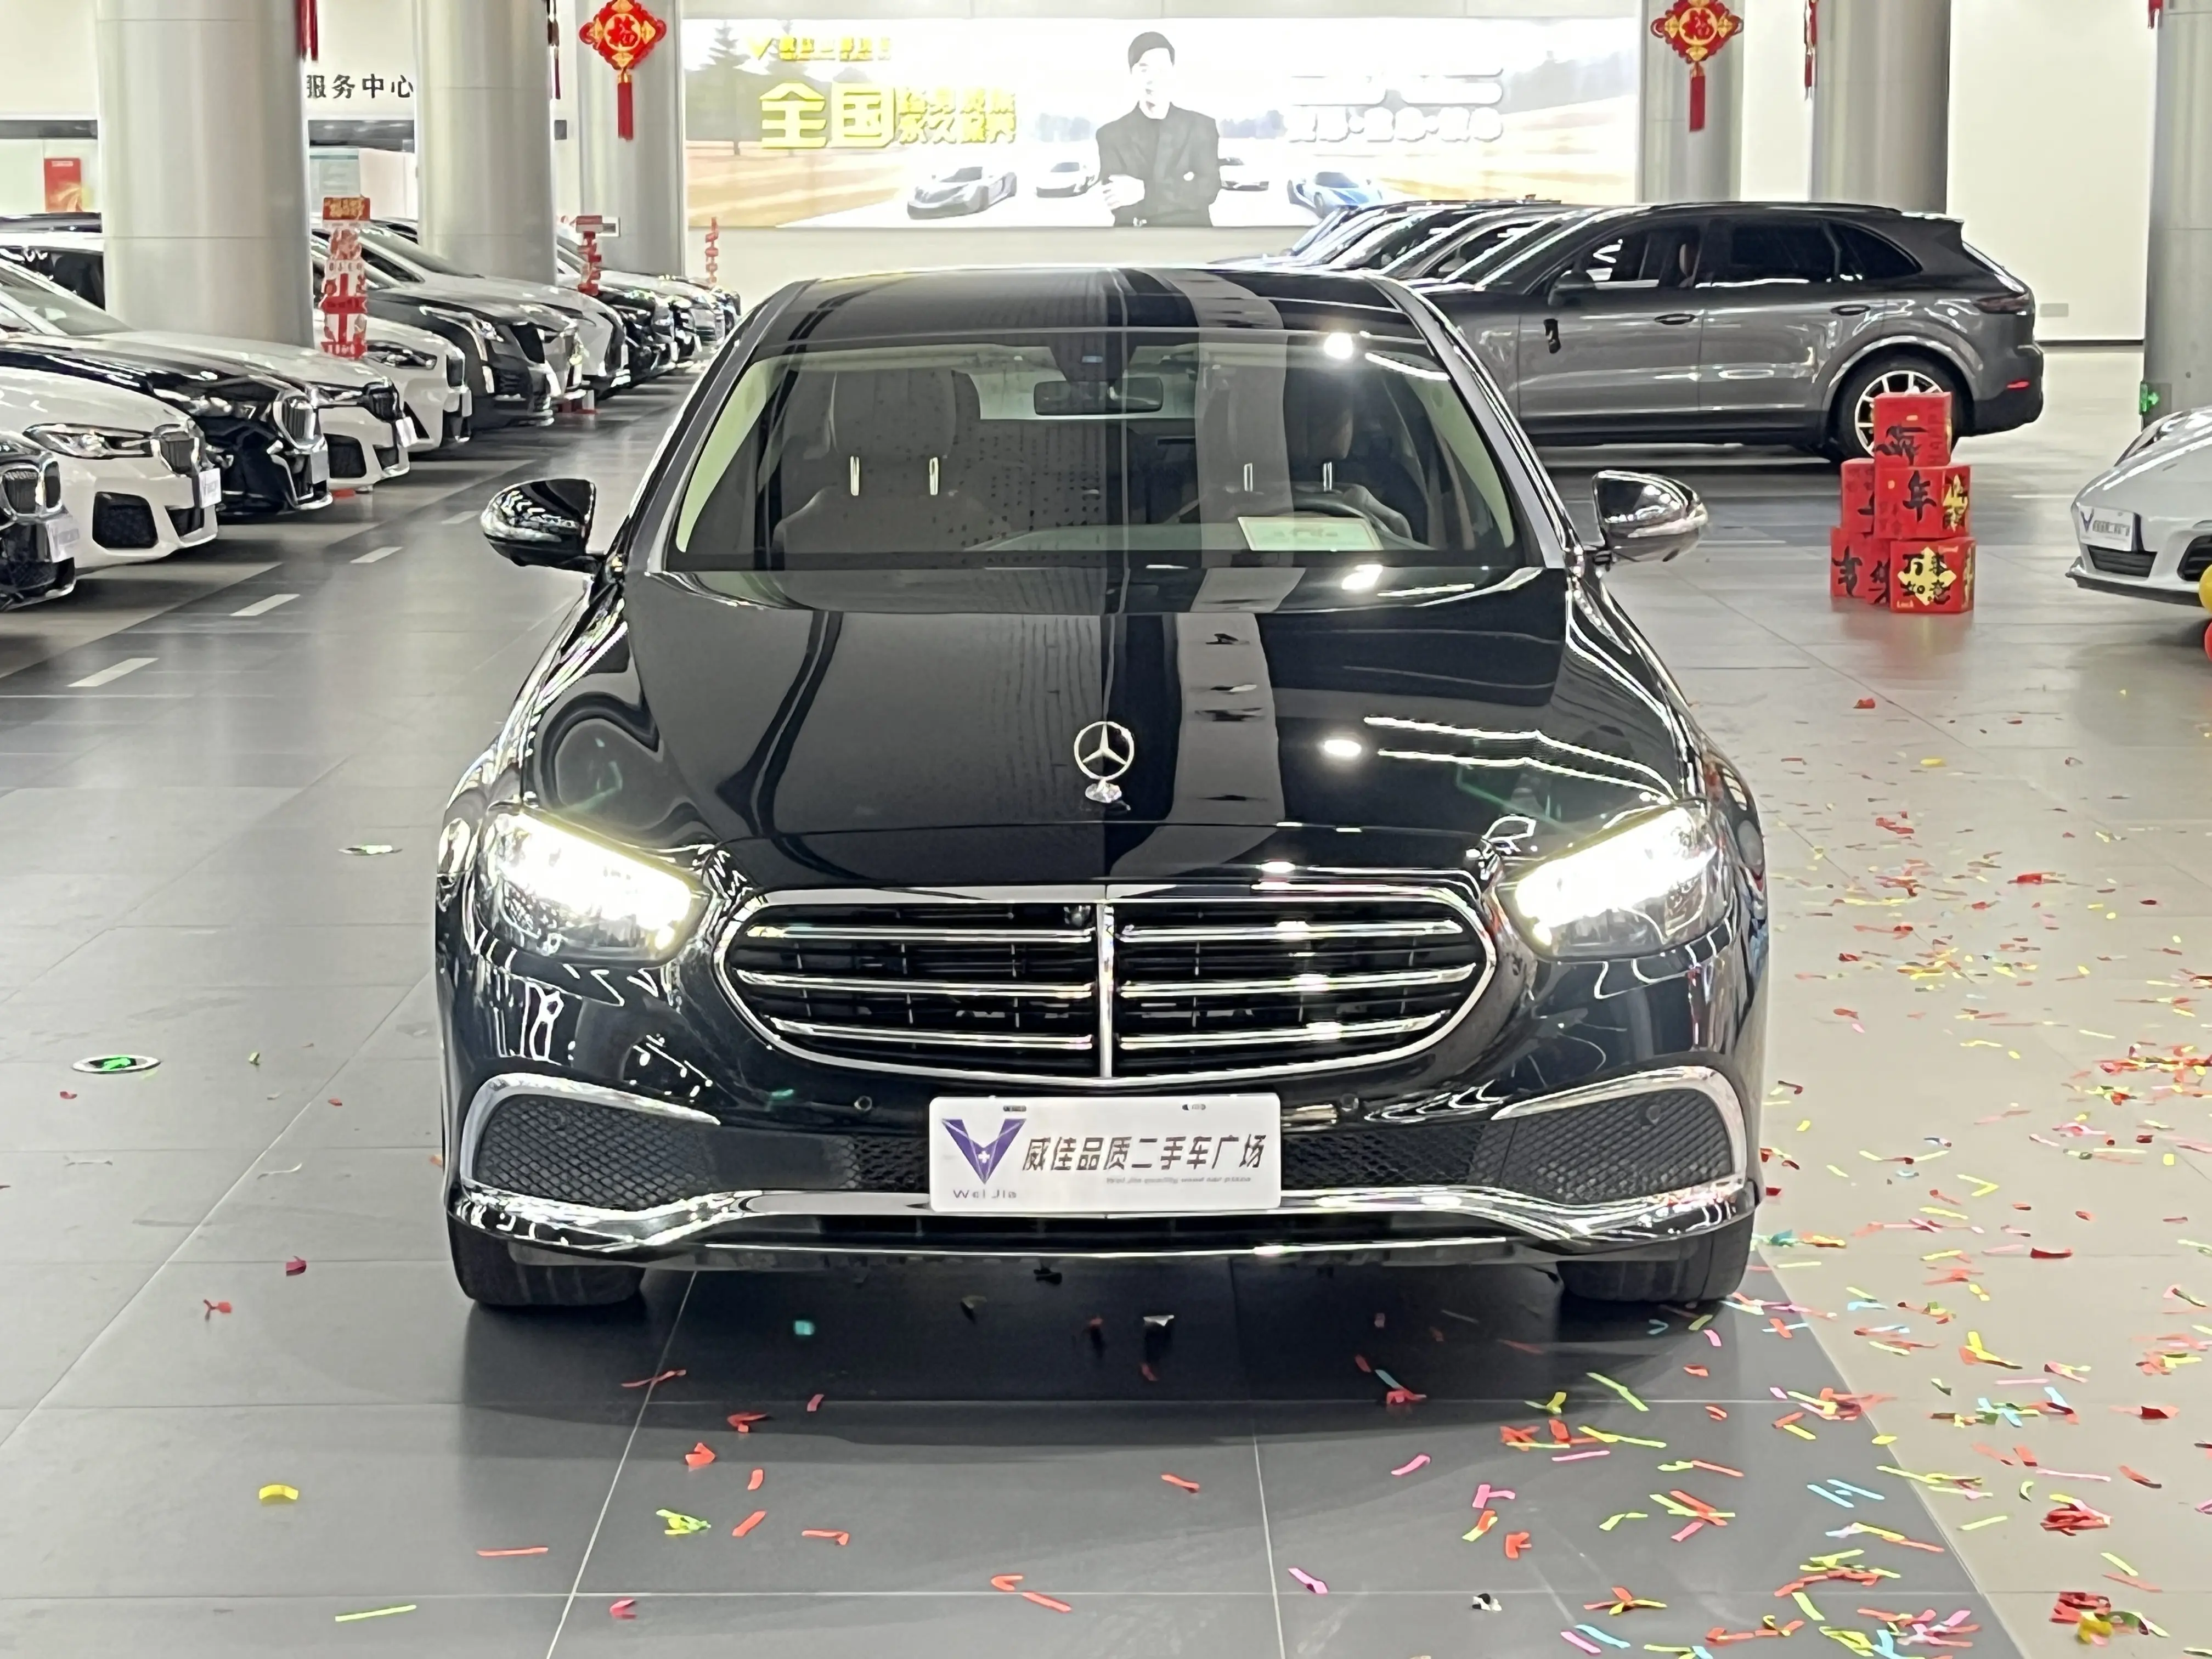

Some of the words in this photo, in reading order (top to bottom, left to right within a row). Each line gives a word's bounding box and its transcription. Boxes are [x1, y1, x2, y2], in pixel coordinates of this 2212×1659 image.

[307, 74, 414, 99] 服务中心
[759, 80, 896, 149] 全国
[1902, 470, 1937, 523] 年
[1022, 1134, 1266, 1170] 威佳品质二手车广场
